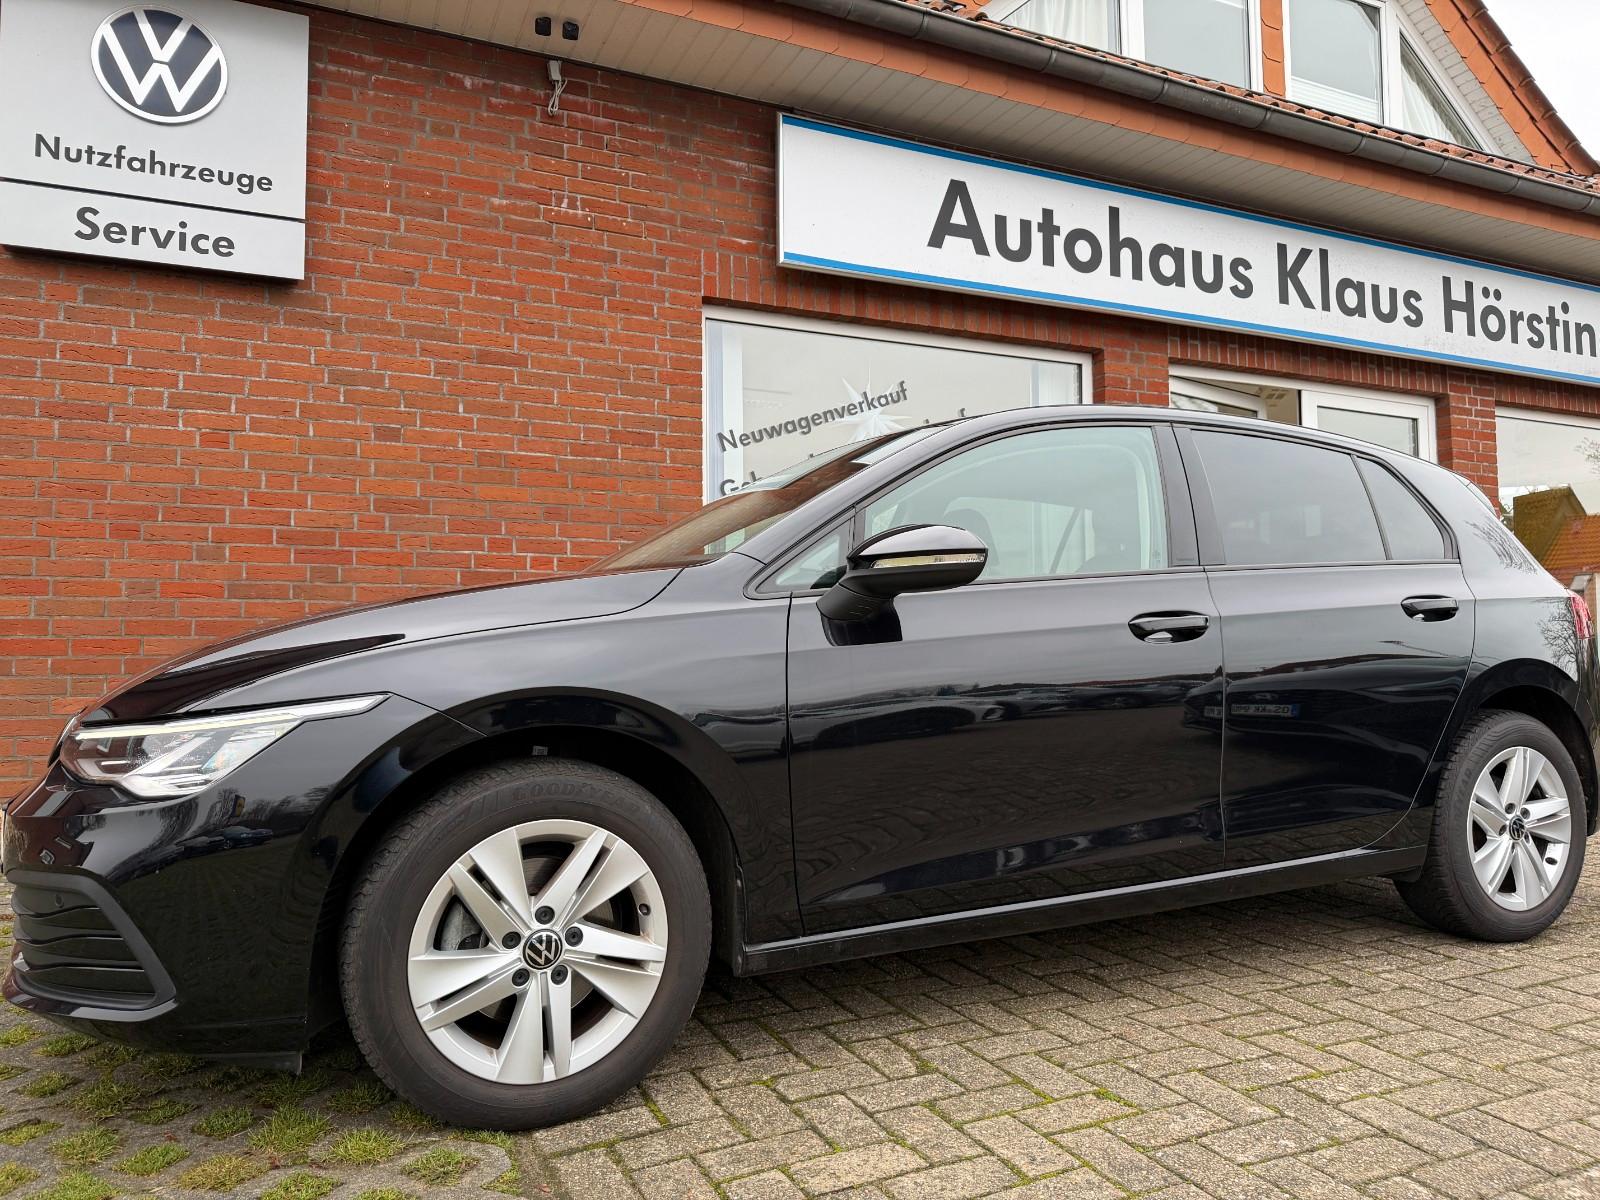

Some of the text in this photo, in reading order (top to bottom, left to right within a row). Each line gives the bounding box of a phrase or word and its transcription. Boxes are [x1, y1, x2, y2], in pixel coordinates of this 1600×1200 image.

[34, 133, 273, 195] Nutzfahrzeuge
[74, 206, 235, 258] Service
[927, 178, 1597, 358] Autohaus Klaus Hörstin
[717, 380, 908, 452] Neuwagenverkauf
